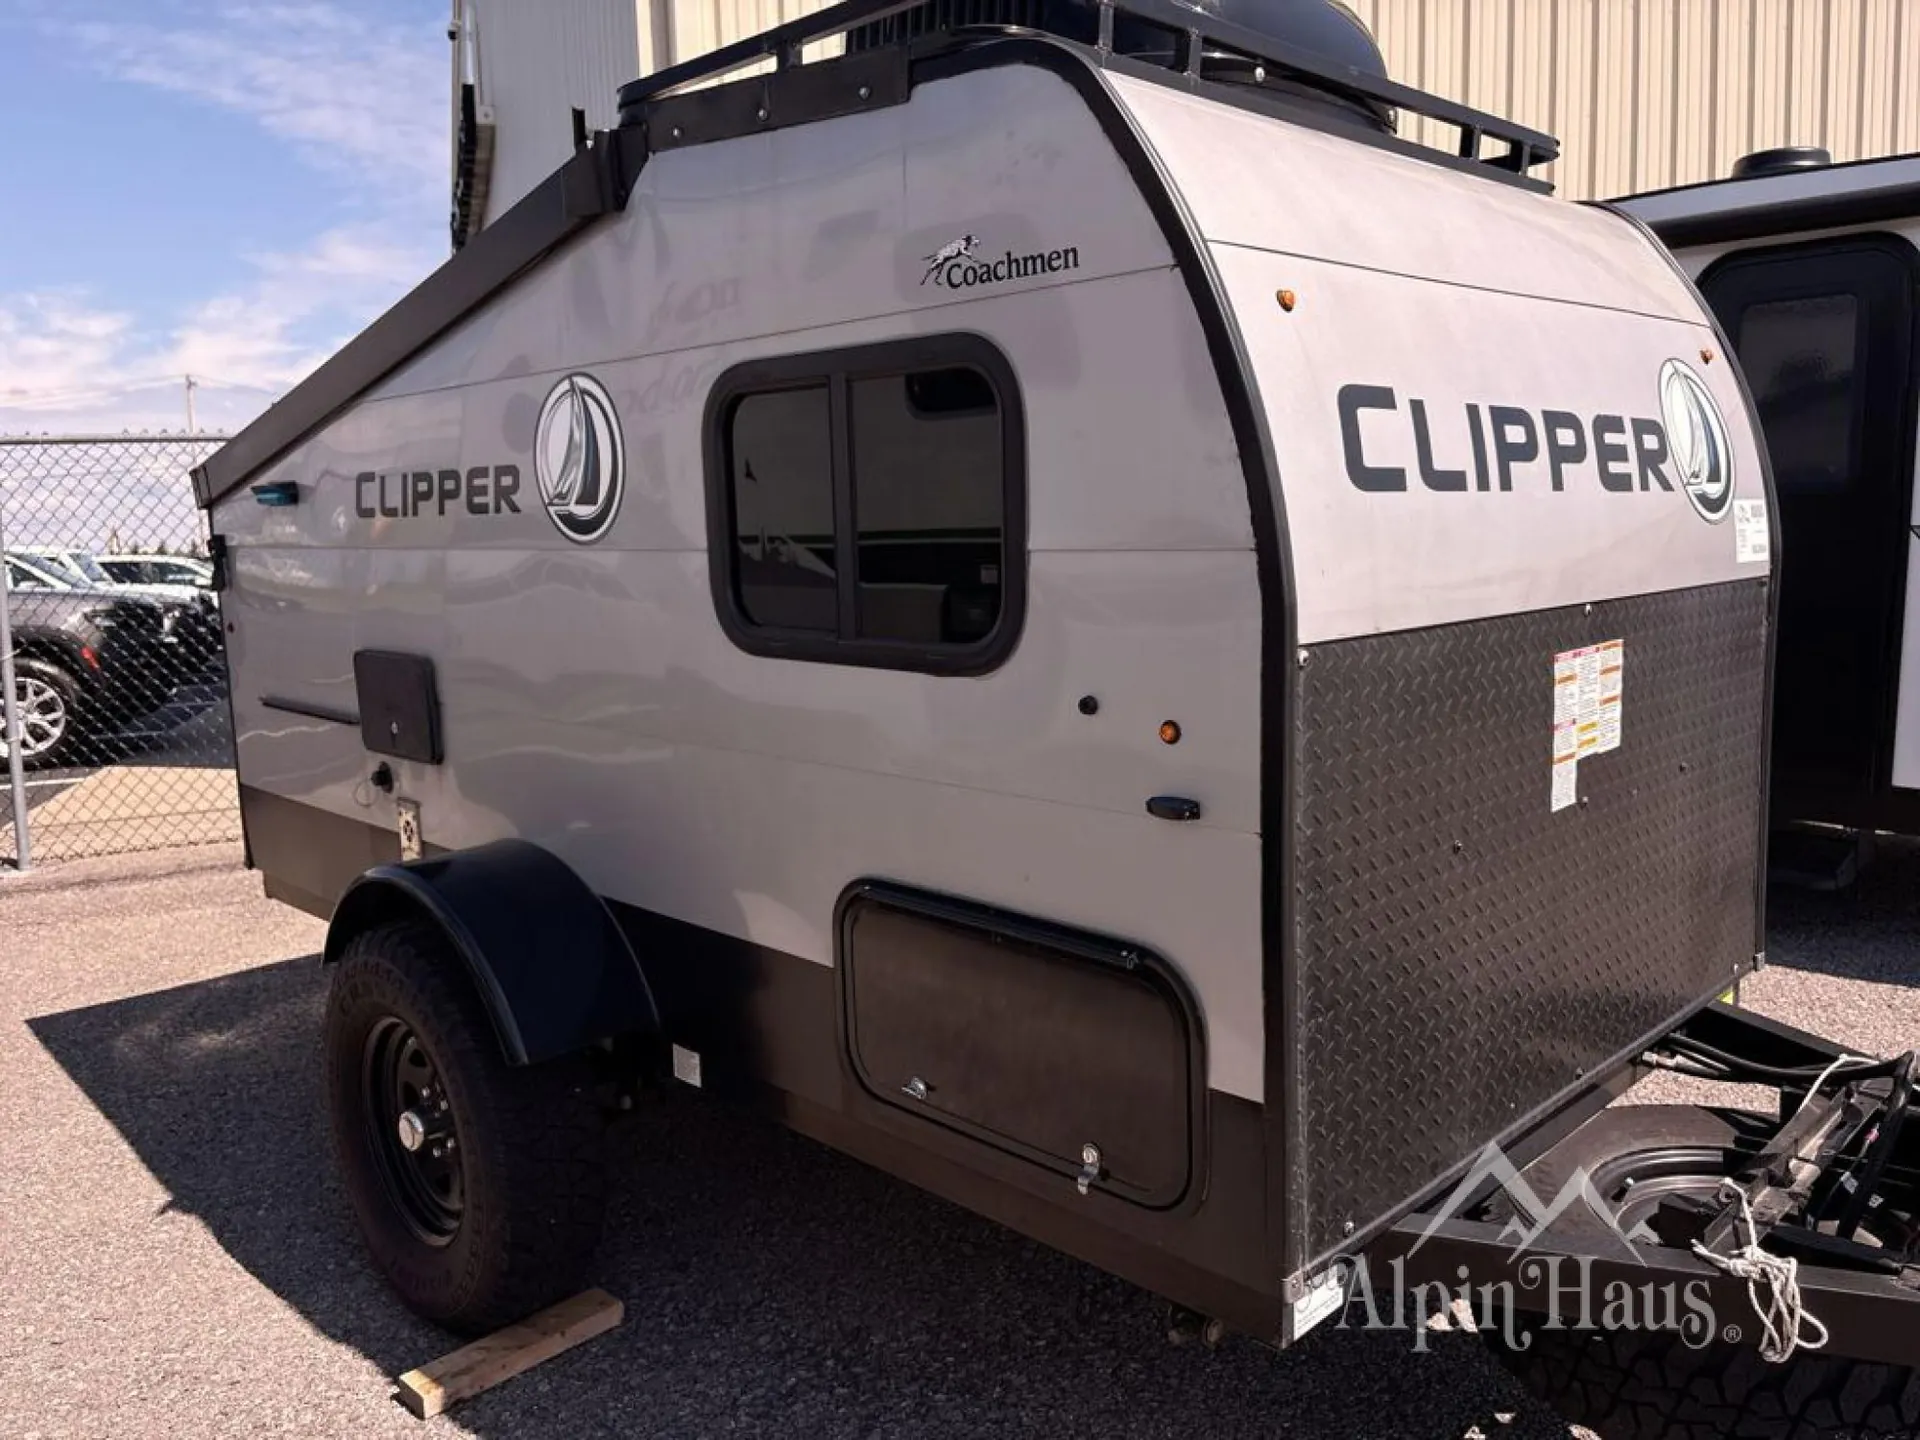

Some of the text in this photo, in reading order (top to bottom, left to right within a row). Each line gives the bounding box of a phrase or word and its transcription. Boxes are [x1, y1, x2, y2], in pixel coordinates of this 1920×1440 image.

[946, 246, 1080, 290] Coachmen
[1336, 383, 1675, 493] CLIPPER
[355, 464, 522, 519] CLIPPER
